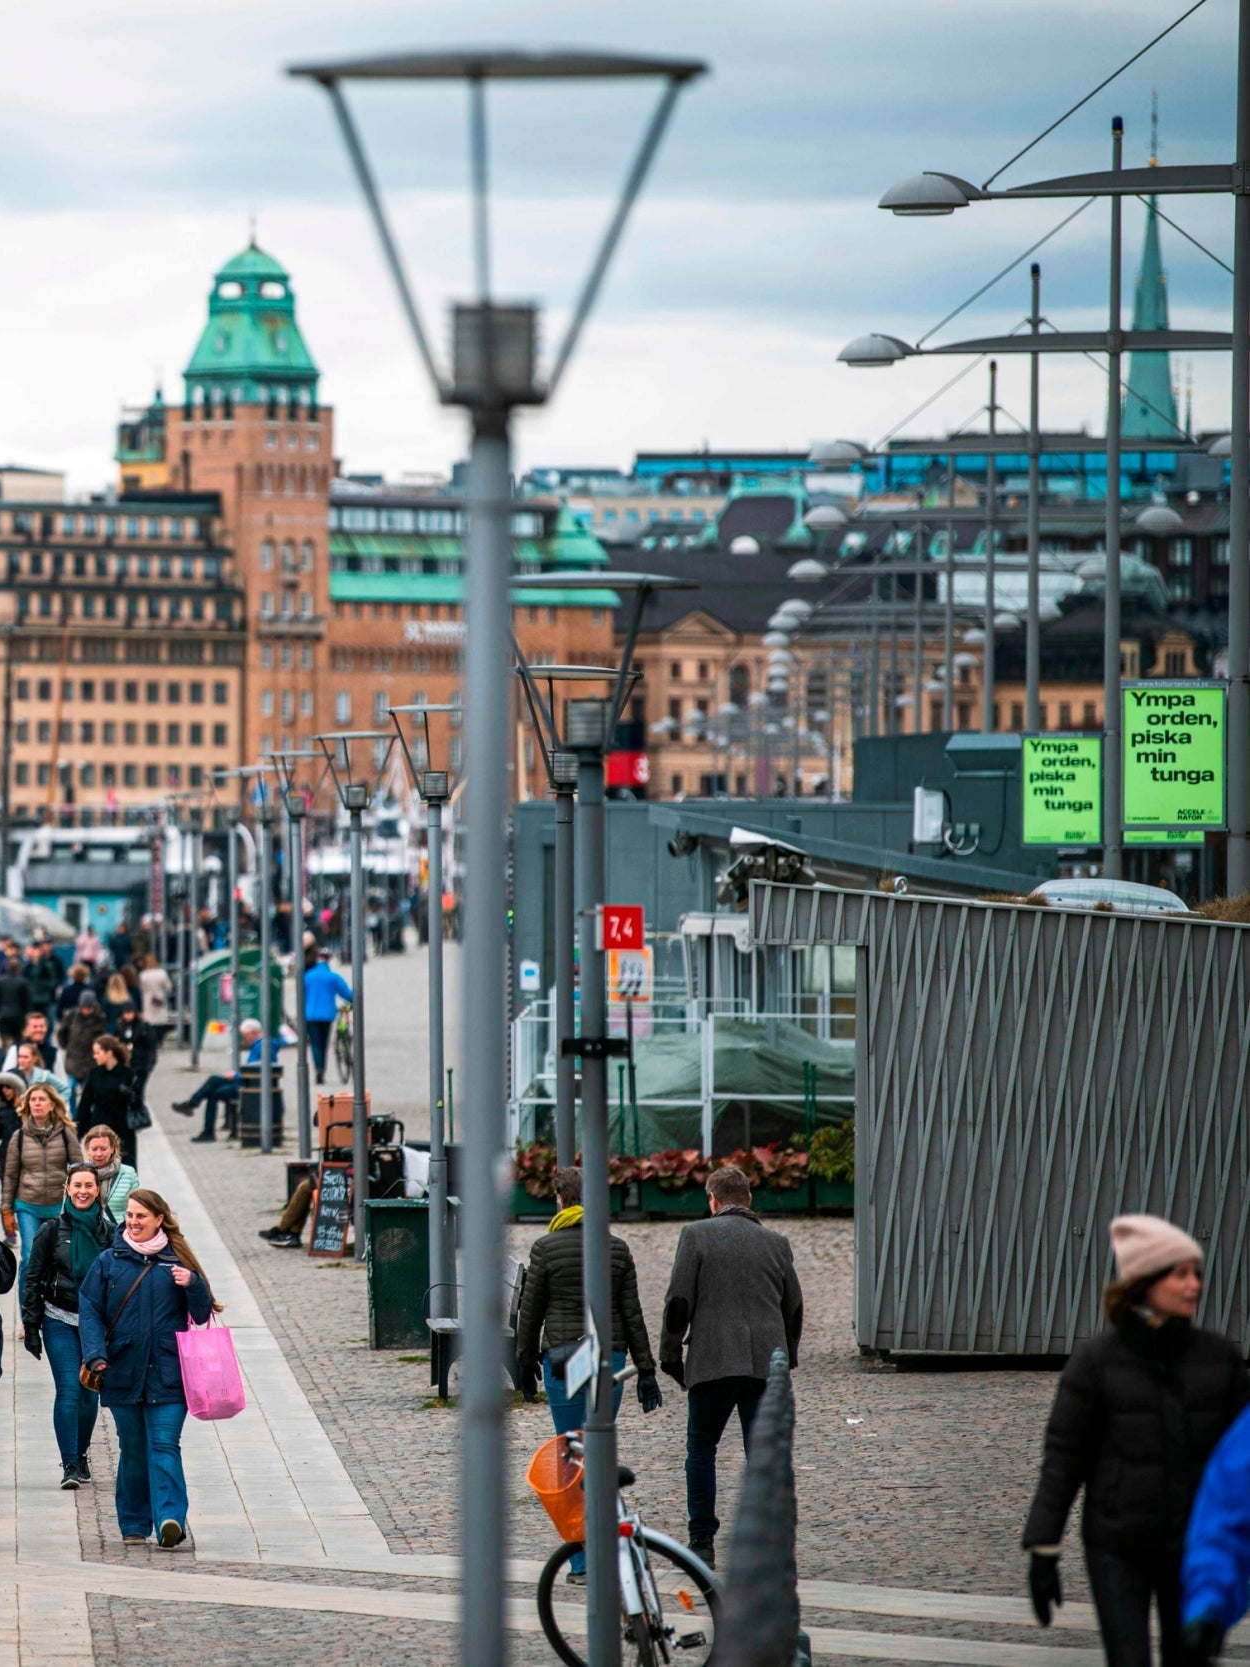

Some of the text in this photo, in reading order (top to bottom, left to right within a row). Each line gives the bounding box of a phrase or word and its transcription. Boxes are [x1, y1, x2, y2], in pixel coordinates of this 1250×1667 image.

[1131, 692, 1195, 709] Ympa
[1147, 711, 1218, 728] orden,
[1131, 730, 1192, 747] piska
[1030, 740, 1079, 755] Ympa
[1041, 755, 1096, 770] orden,
[1136, 749, 1176, 763] min
[1030, 770, 1076, 784] piska
[1150, 767, 1214, 785] tunga
[1033, 786, 1064, 796] min
[1044, 799, 1093, 813] tunga
